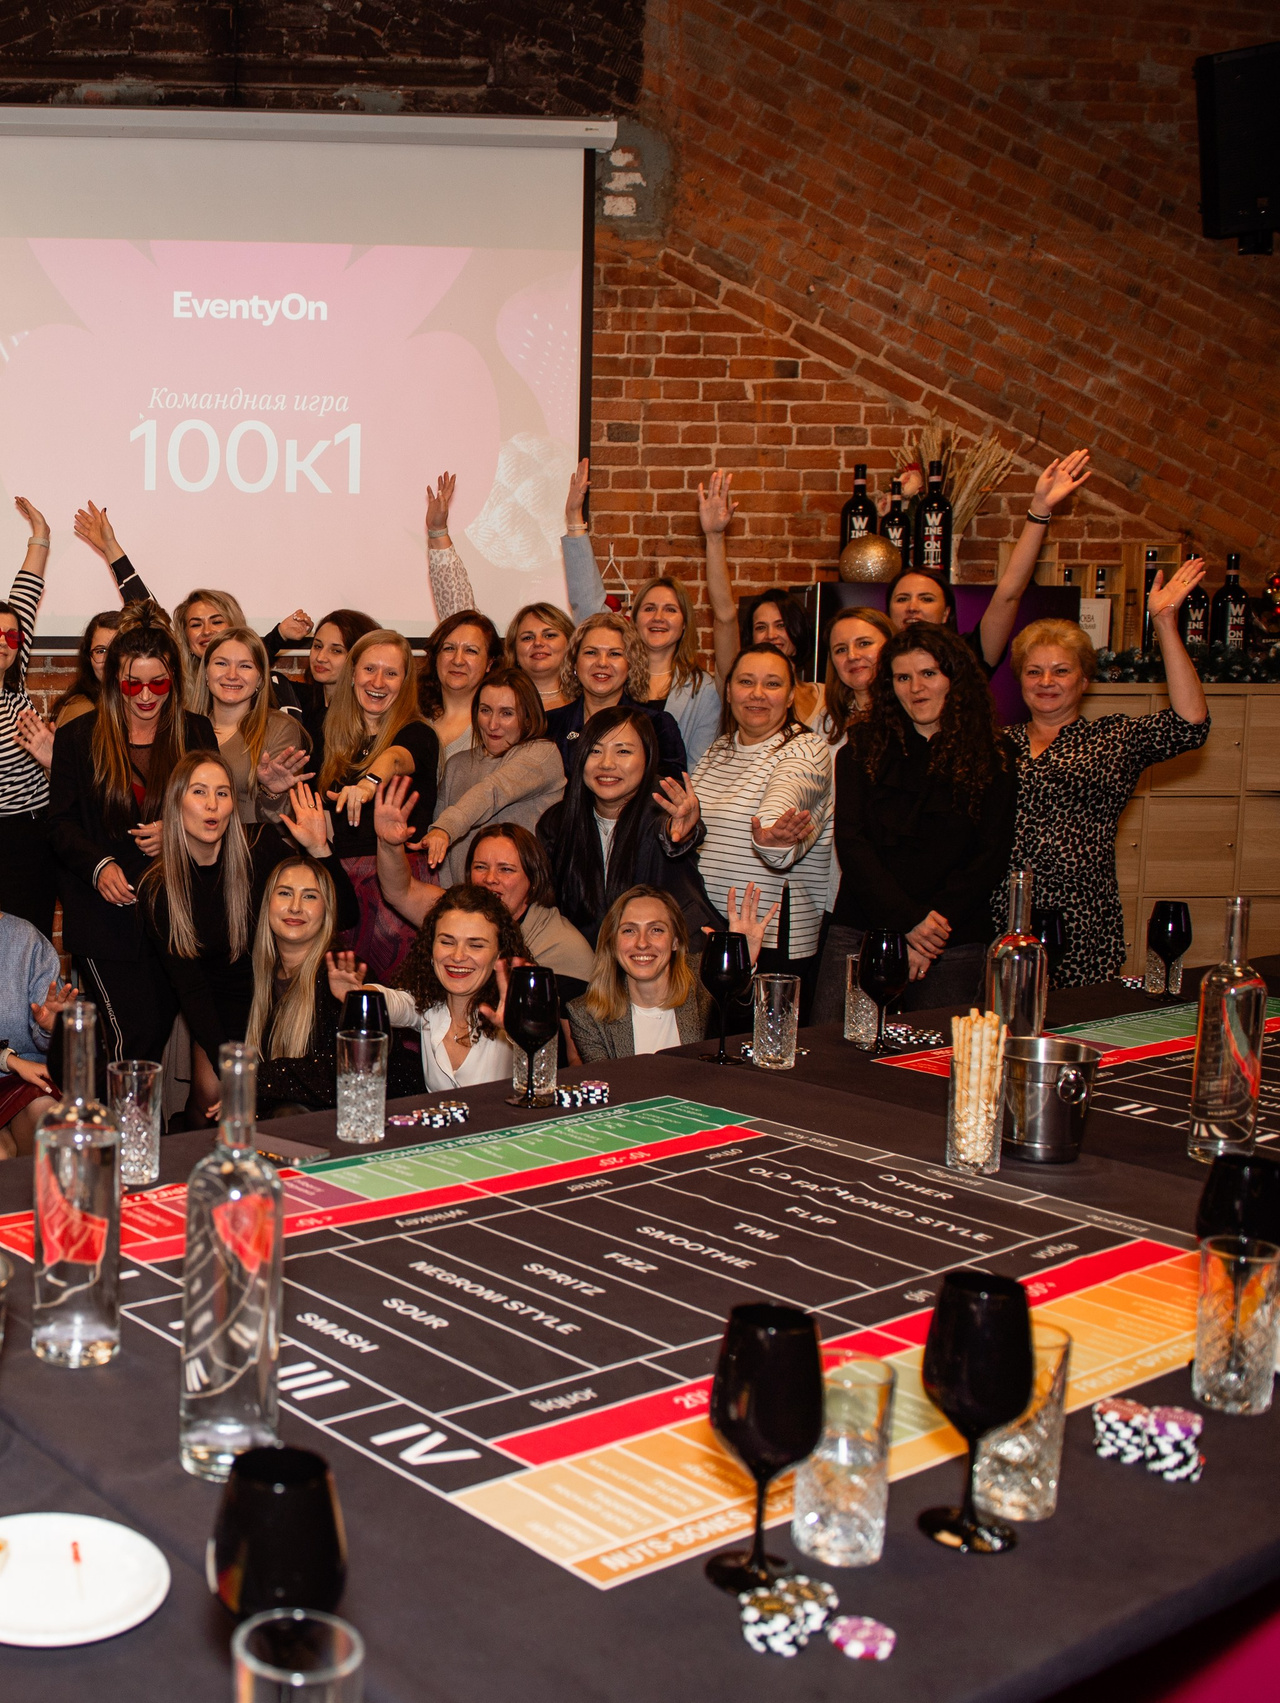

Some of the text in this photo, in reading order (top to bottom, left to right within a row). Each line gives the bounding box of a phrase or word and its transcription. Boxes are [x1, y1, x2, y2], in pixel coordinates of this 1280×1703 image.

[173, 291, 328, 326] EventyOn
[147, 387, 350, 416] Командная игра
[130, 419, 361, 494] 100к1
[924, 526, 943, 535] INE
[924, 541, 941, 549] ON
[566, 1178, 613, 1192] bitter
[878, 1174, 954, 1201] OTHER
[926, 1168, 985, 1188] digestif
[748, 1167, 792, 1181] OLD
[914, 1215, 994, 1243] STYLE
[785, 1206, 837, 1225] FLIP
[733, 1222, 780, 1241] TINI
[636, 1225, 757, 1269] SMOOTHIE
[1030, 1242, 1080, 1260] vodka
[603, 1252, 659, 1273] FIZZ
[523, 1262, 606, 1296] SPRITZ
[408, 1261, 582, 1335] NEGRONI STYLE
[903, 1288, 936, 1303] gin
[382, 1297, 449, 1330] SOUR
[296, 1311, 379, 1354] SMASH
[529, 1387, 598, 1413] liquor
[370, 1423, 482, 1466] IV
